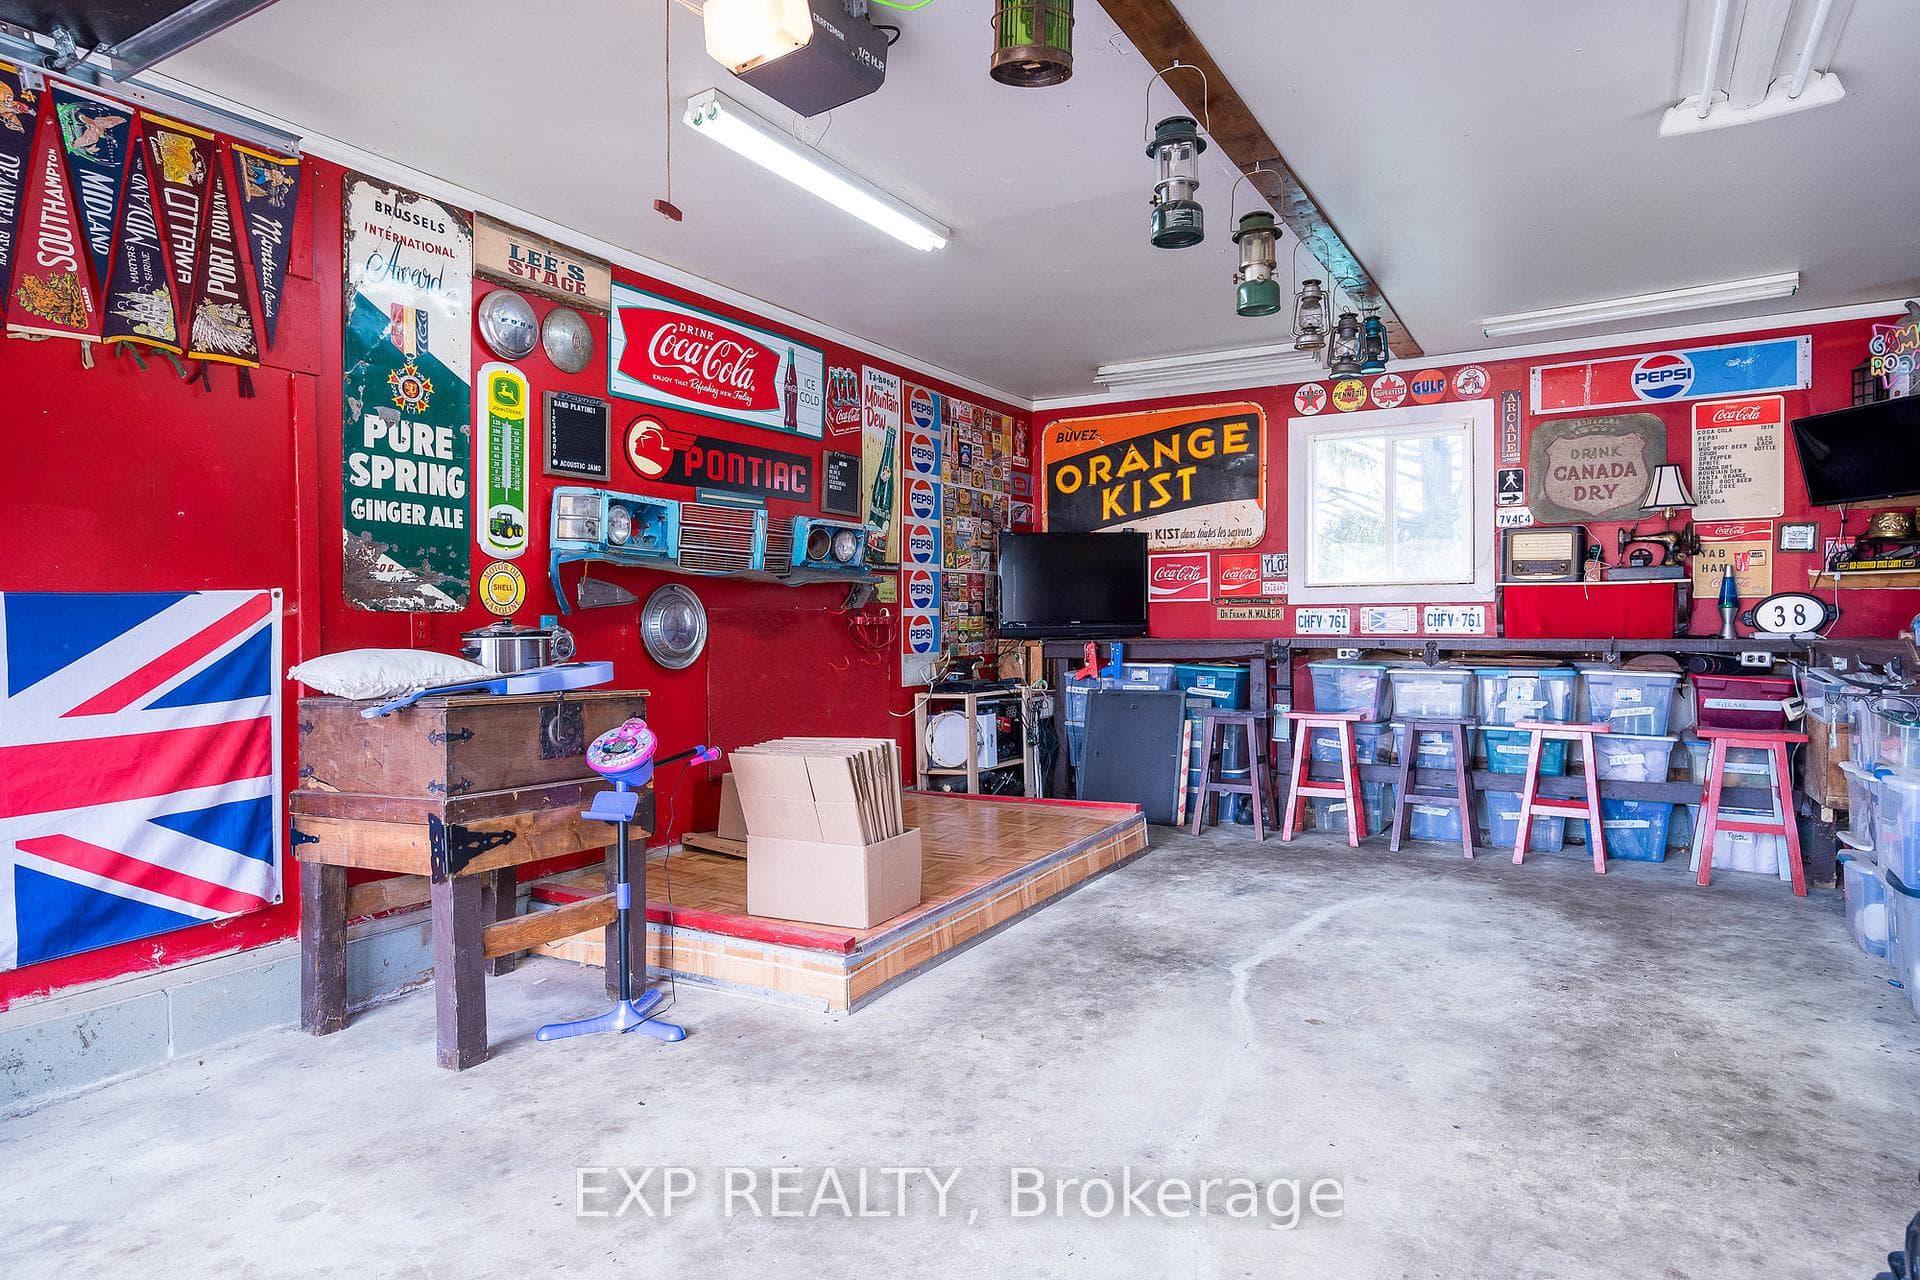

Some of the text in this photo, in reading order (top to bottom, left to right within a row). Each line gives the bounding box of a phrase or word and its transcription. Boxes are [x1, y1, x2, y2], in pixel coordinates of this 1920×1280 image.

[813, 12, 846, 42] CRAFTSMAN
[36, 147, 78, 272] SOUTHAMPTON
[79, 168, 115, 257] MIDLAND
[125, 173, 160, 251] MIDLAND
[209, 192, 233, 243] ROWAN
[374, 199, 446, 235] BRUSSELS
[164, 187, 200, 285] OTTAWA
[363, 221, 456, 259] INTERNATIONAL
[251, 212, 284, 292] Montreal
[142, 251, 154, 281] SHRINE
[206, 240, 240, 299] PORT
[366, 241, 450, 297] Award
[509, 243, 585, 282] LEE'S
[508, 258, 587, 297] STAGE
[679, 321, 715, 341] DRINK
[1869, 324, 1920, 356] GAM
[648, 322, 759, 391] Coca-Cola
[652, 374, 673, 384] ENJOY
[674, 378, 689, 387] THAT
[803, 376, 816, 391] ICE
[1635, 367, 1692, 384] PEPSI
[1412, 380, 1445, 396] GULF
[553, 399, 569, 409] BAND
[799, 391, 820, 408] COLD
[865, 384, 899, 415] Mountain
[911, 400, 934, 416] PEPSI
[505, 407, 522, 415] DEERE
[865, 405, 887, 430] Dew
[1713, 405, 1761, 423] Coca-Cola
[1506, 393, 1517, 453] ARCADE
[364, 414, 454, 460] PURE
[911, 446, 934, 461] PEPSI
[1055, 422, 1250, 495] ORANGE
[1571, 446, 1623, 460] DRINK
[559, 460, 586, 470] ACOUSTIC
[684, 443, 807, 495] PONTIAC
[1553, 462, 1638, 482] CANADA
[348, 452, 467, 499] SPRING
[911, 492, 934, 506] PEPSI
[1101, 466, 1198, 521] KIST
[1573, 483, 1620, 501] DRY
[350, 497, 464, 529] GINGER ALE
[1499, 514, 1531, 524] 7V4C4
[1155, 528, 1181, 540] KIST
[1180, 528, 1196, 539] dans
[1197, 527, 1218, 538] toutes
[1217, 526, 1228, 538] les
[1227, 526, 1253, 538] saveurs
[1715, 525, 1745, 536] Coca-Cola
[911, 538, 933, 551] PEPSI
[1700, 549, 1726, 558] TAB
[484, 563, 521, 580] MOTOR OIL
[1154, 565, 1203, 582] Coca-Cola
[1222, 567, 1258, 581] Coca-Cola
[493, 583, 513, 592] SHELL
[910, 583, 933, 595] PEPSI
[485, 597, 521, 614] GASOLINE
[1298, 615, 1347, 628] CHFV 761
[1427, 613, 1482, 627] CHFV 761
[1773, 604, 1808, 628] 38
[910, 628, 933, 640] PEPSI
